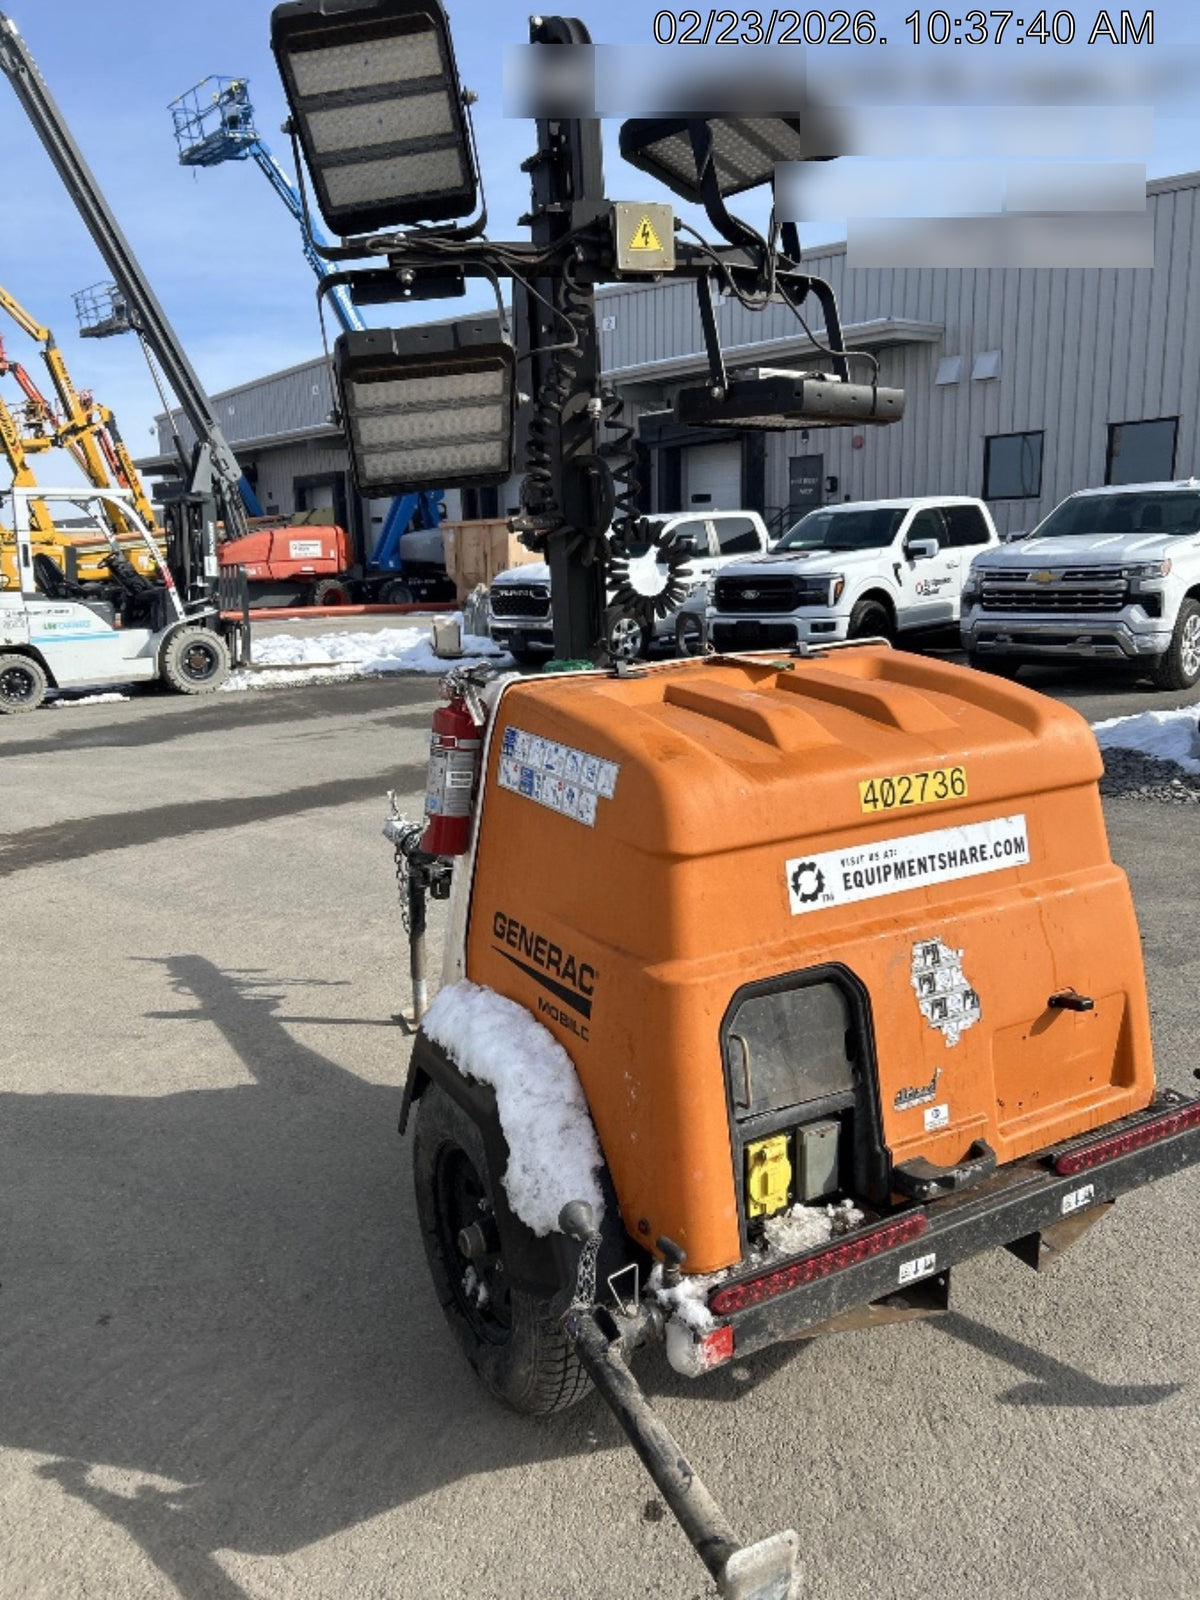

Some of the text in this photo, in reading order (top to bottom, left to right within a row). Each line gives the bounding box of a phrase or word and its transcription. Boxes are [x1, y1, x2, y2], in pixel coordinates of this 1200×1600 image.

[863, 767, 966, 809] 402736
[842, 836, 1025, 891] EQUIPMENTSHARE.COM
[493, 911, 595, 996] GENERAC
